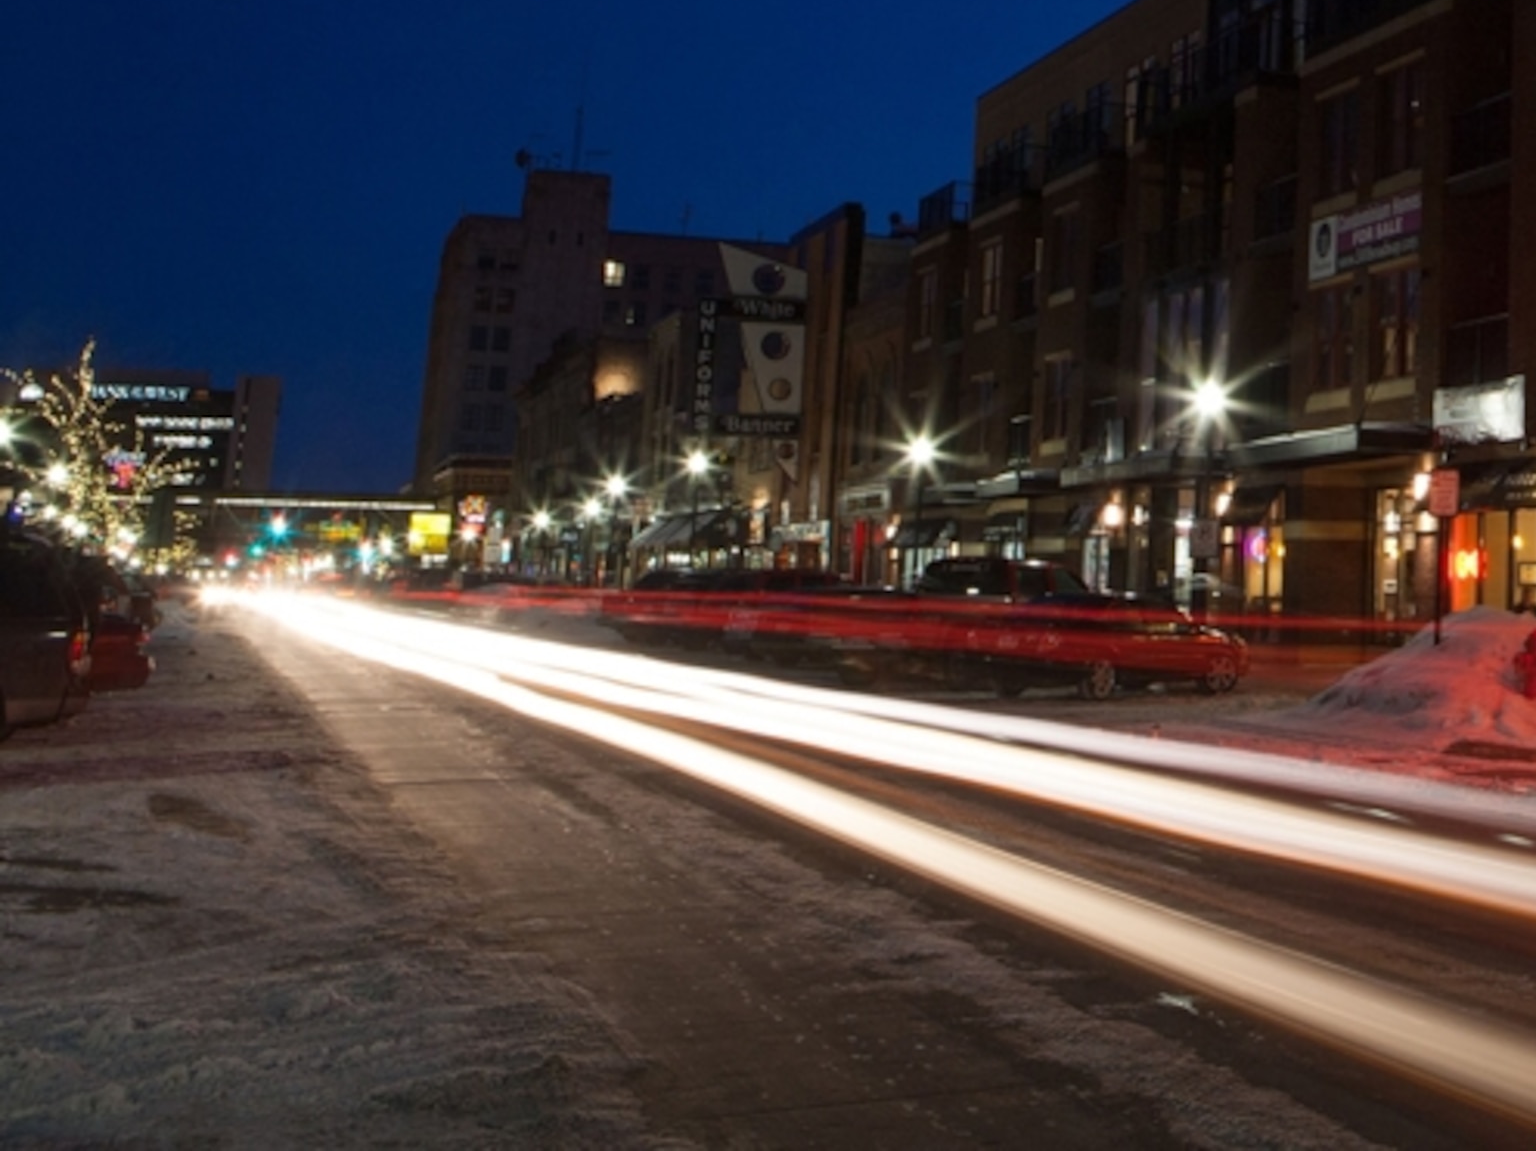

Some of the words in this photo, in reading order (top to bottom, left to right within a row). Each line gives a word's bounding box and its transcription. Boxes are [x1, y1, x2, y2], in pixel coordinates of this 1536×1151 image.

[1351, 225, 1374, 247] FOR
[1376, 216, 1404, 240] SALE
[737, 299, 796, 318] White
[694, 300, 716, 431] UNIFORMS
[721, 416, 796, 433] Banner
